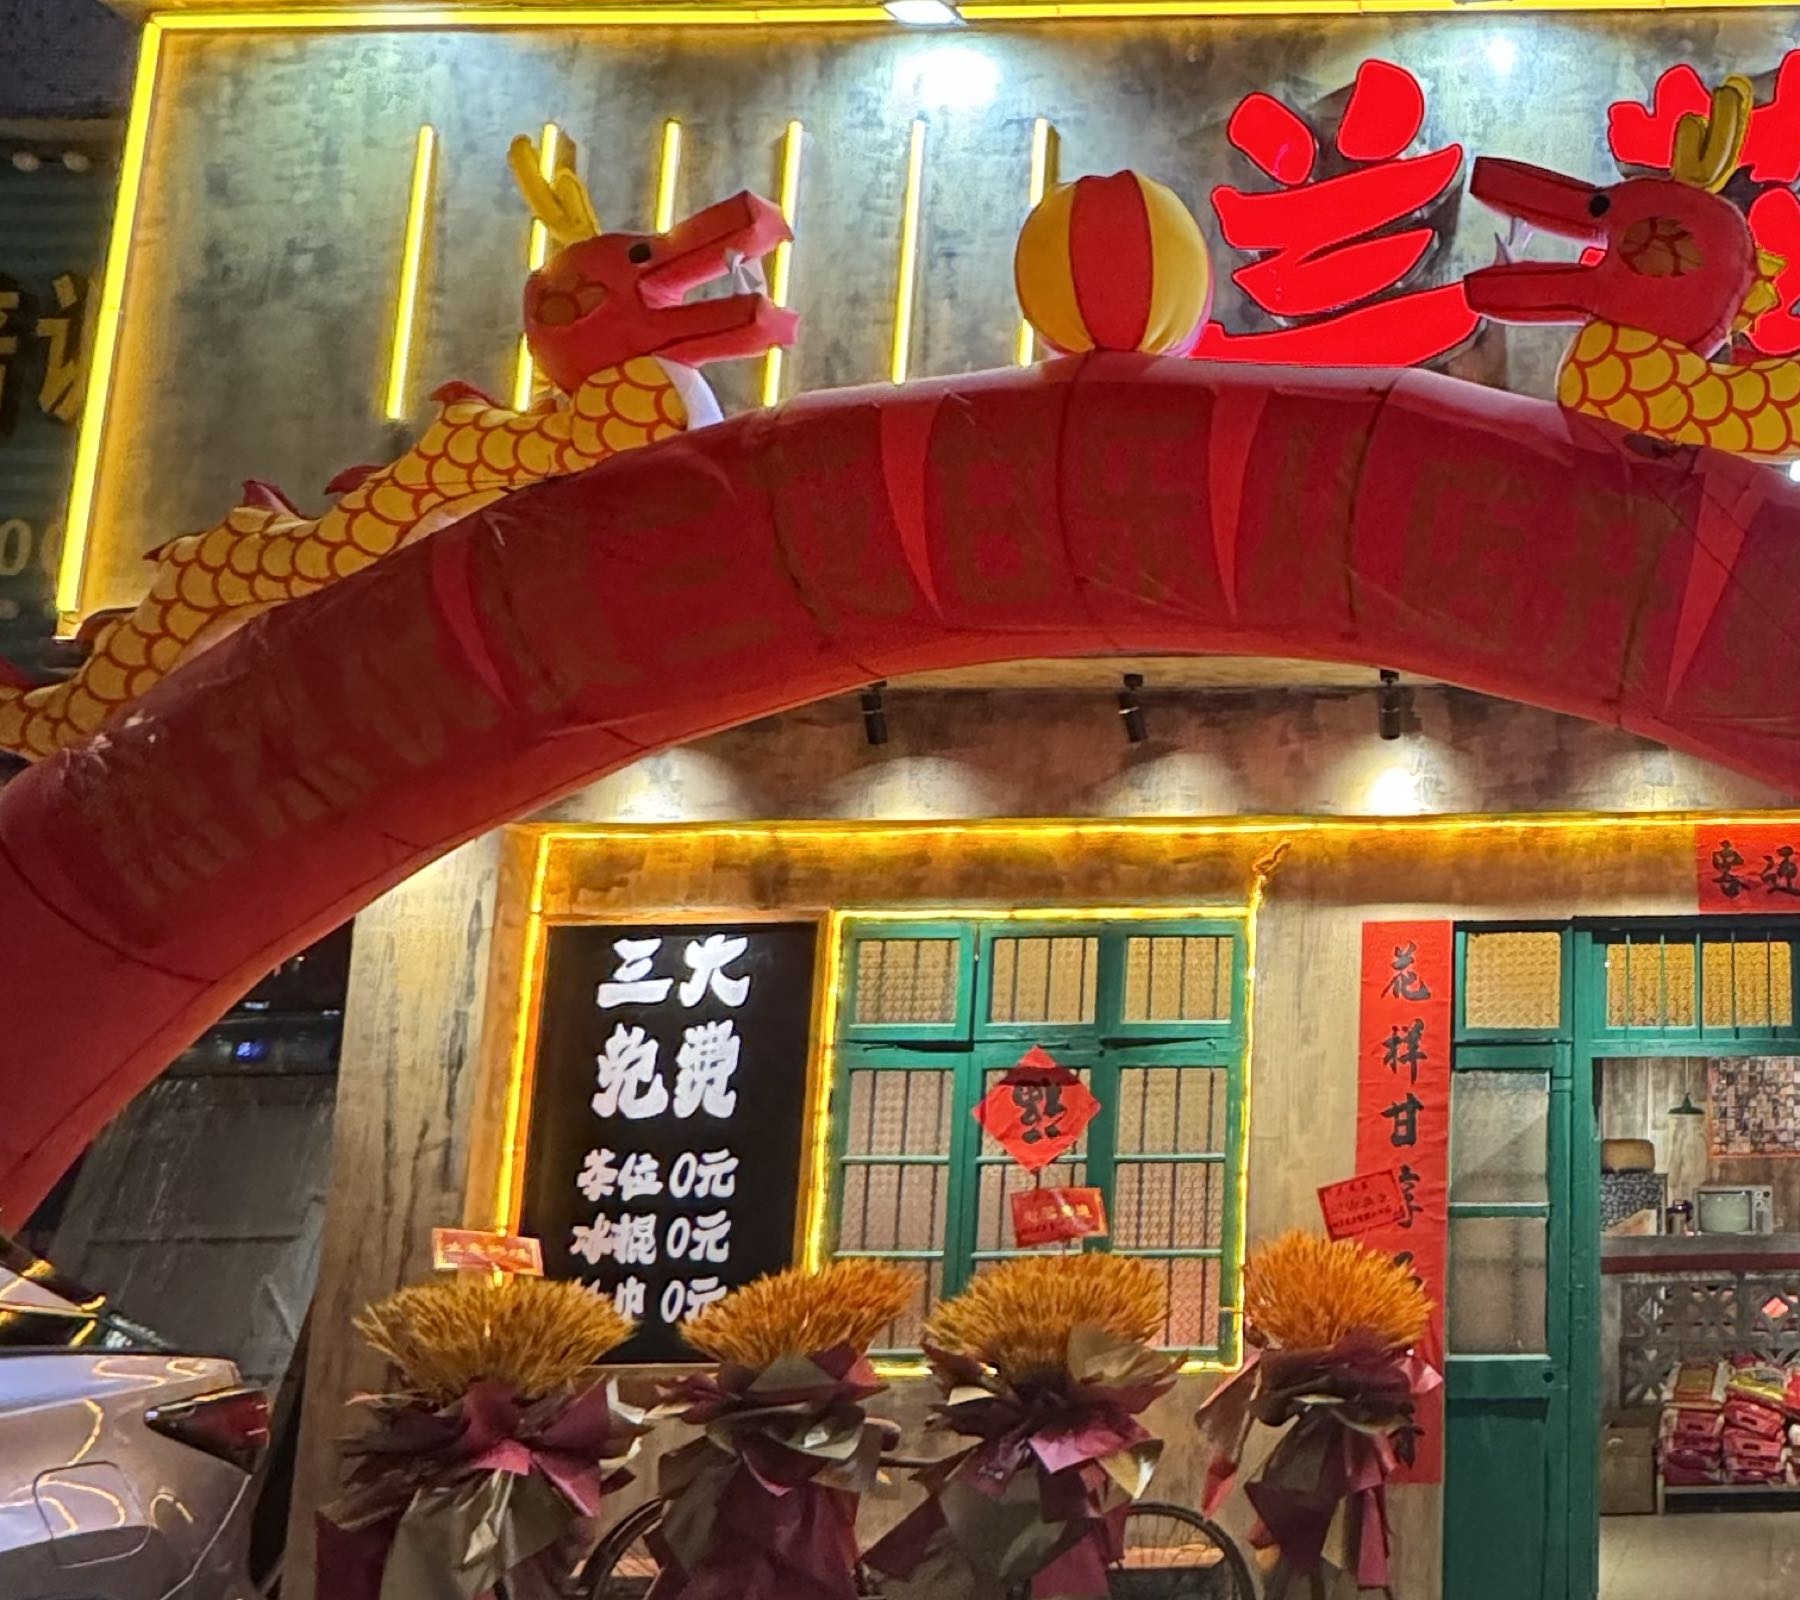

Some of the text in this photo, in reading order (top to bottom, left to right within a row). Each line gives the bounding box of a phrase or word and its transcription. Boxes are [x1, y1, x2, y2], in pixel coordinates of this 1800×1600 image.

[597, 933, 750, 1008] 三大
[591, 1018, 742, 1120] 免费
[576, 1148, 740, 1202] 茶位 0元
[569, 1212, 658, 1265] 冰棍
[666, 1210, 732, 1263] 0元
[569, 1276, 647, 1322] 巾
